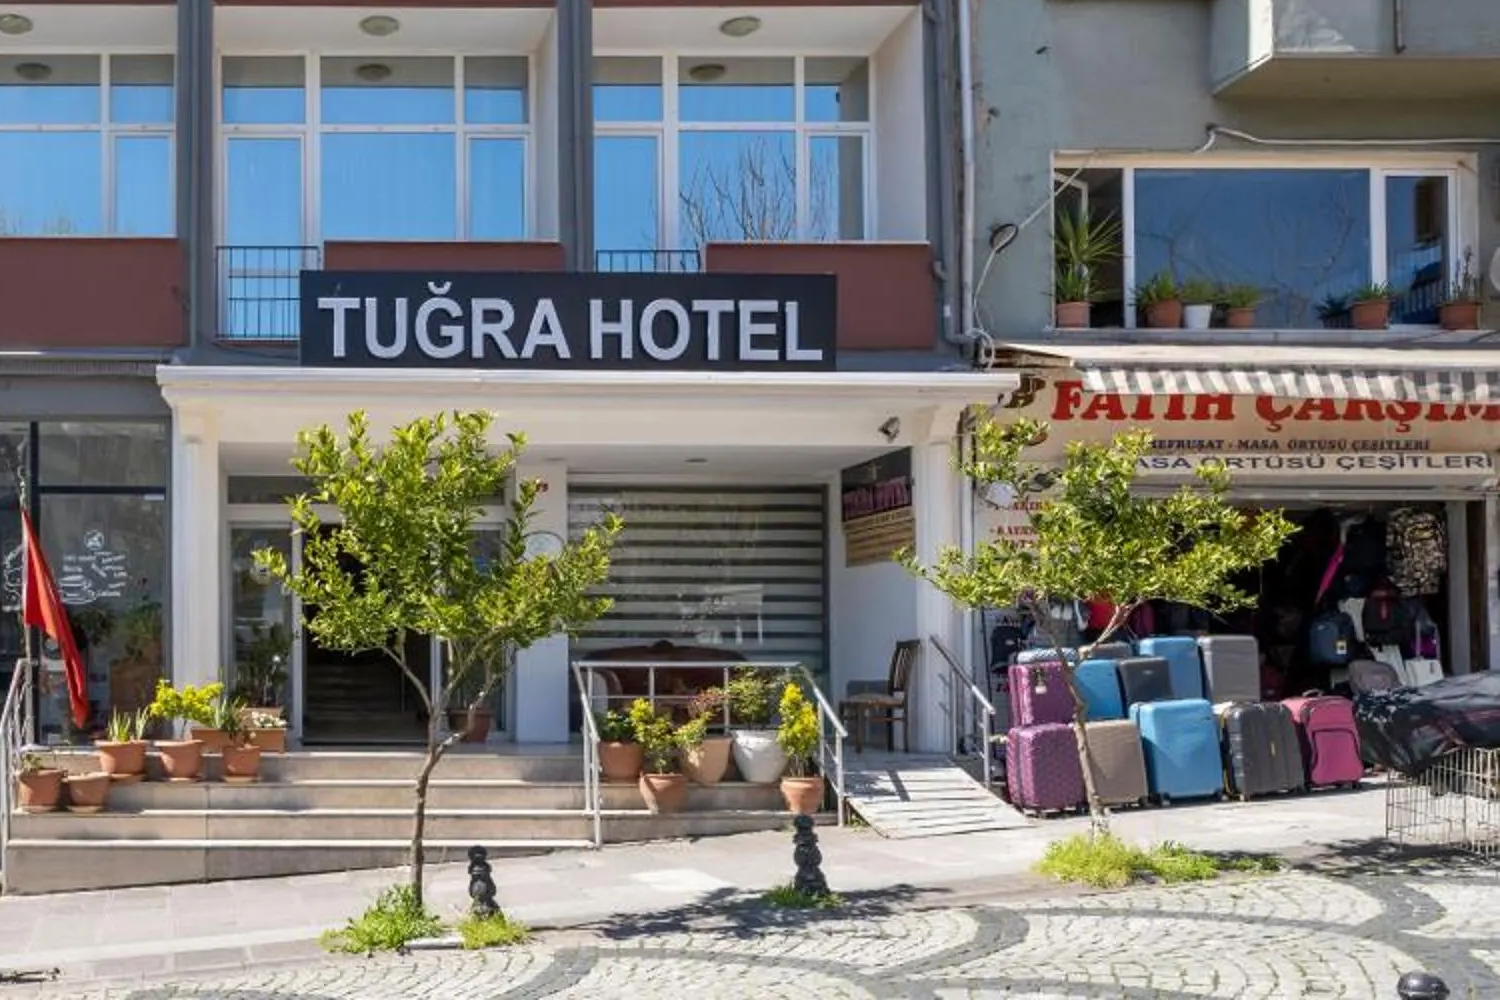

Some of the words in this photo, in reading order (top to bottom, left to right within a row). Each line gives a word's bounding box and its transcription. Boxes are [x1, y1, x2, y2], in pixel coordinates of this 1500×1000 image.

[317, 281, 571, 359] TUĞRA
[589, 299, 823, 361] HOTEL
[1138, 457, 1192, 469] SA
